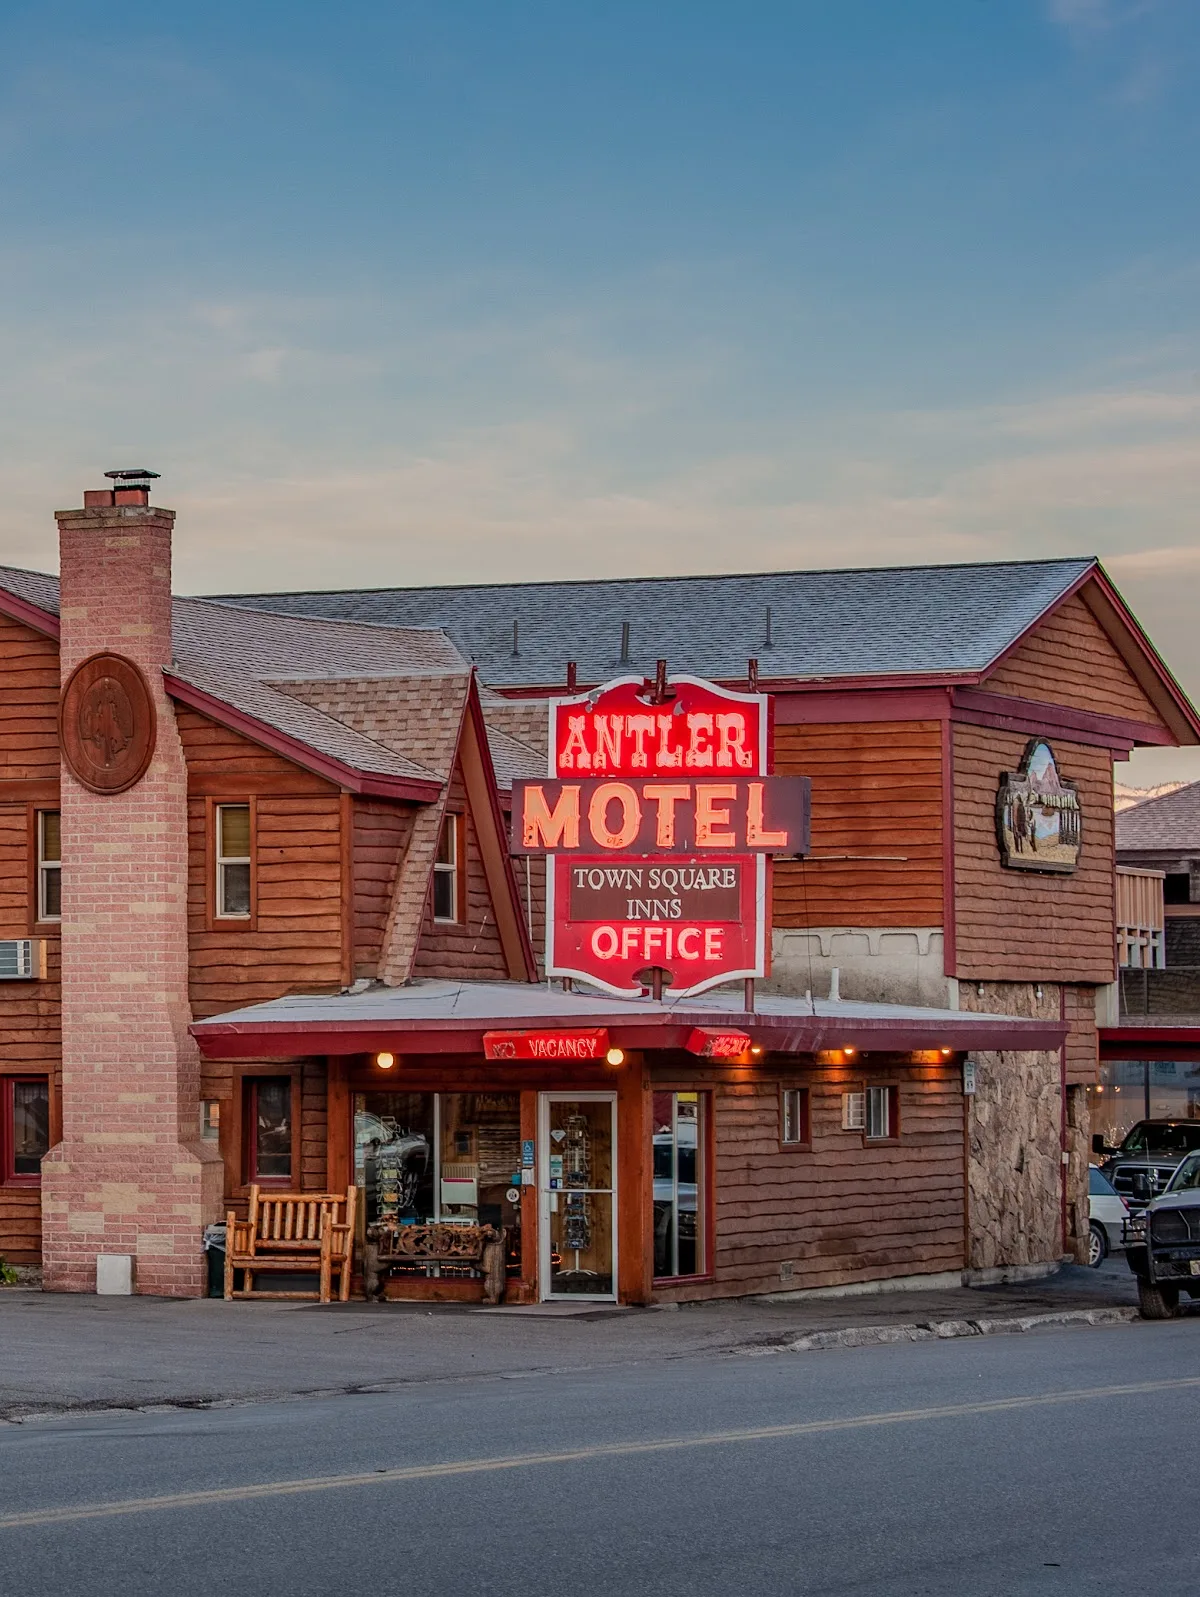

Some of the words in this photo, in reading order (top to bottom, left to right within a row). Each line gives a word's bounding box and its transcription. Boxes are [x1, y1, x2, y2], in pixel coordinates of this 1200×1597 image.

[559, 712, 753, 770] ANTLER
[522, 781, 789, 850] MOTEL
[574, 868, 643, 891] TOWN
[648, 867, 737, 895] SQUARE
[626, 898, 682, 921] INNS
[591, 926, 724, 961] OFFICE
[528, 1038, 597, 1058] VACANCY
